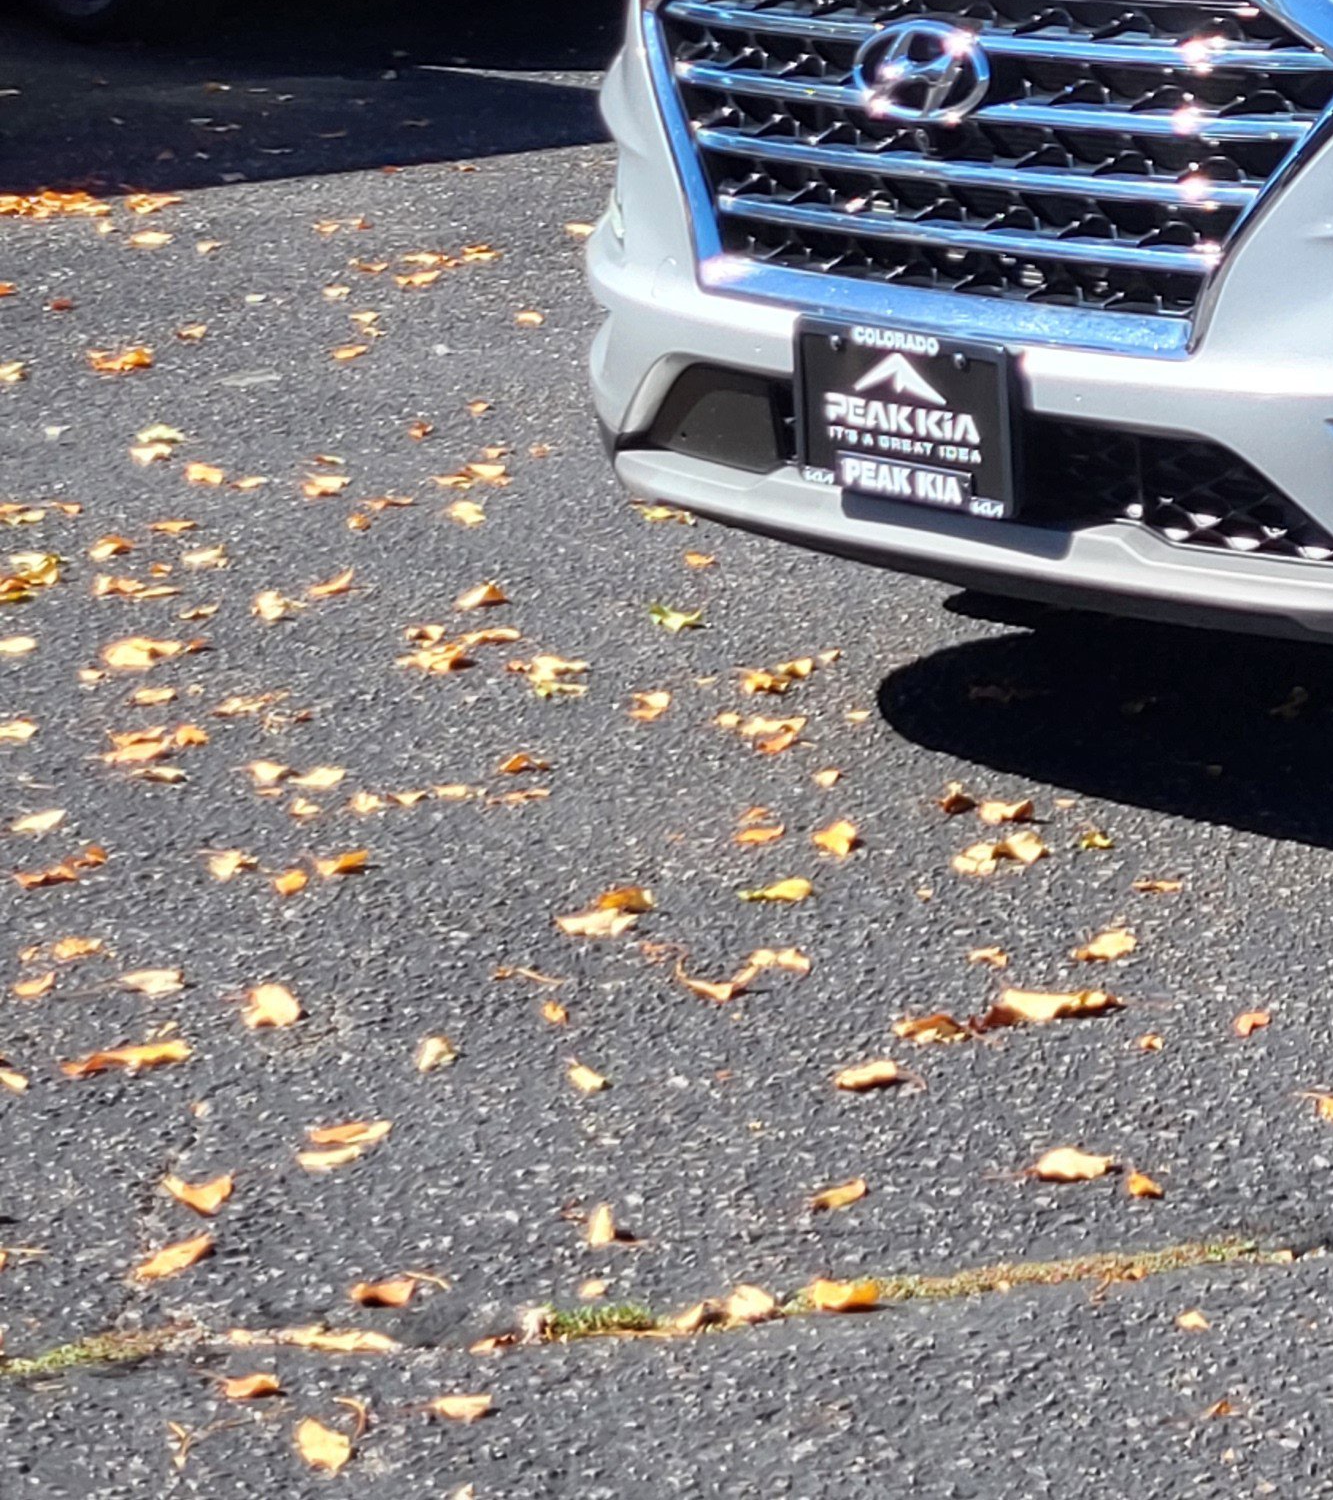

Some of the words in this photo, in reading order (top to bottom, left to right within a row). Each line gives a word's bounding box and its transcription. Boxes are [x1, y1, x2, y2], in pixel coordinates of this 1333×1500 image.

[852, 325, 939, 357] COLORADO
[824, 392, 915, 435] PEAK
[828, 426, 857, 444] IT'S
[862, 433, 874, 446] A
[878, 435, 933, 457] GREAT
[938, 445, 982, 464] IDEA
[841, 457, 912, 496] PEAK
[915, 470, 963, 506] KIA
